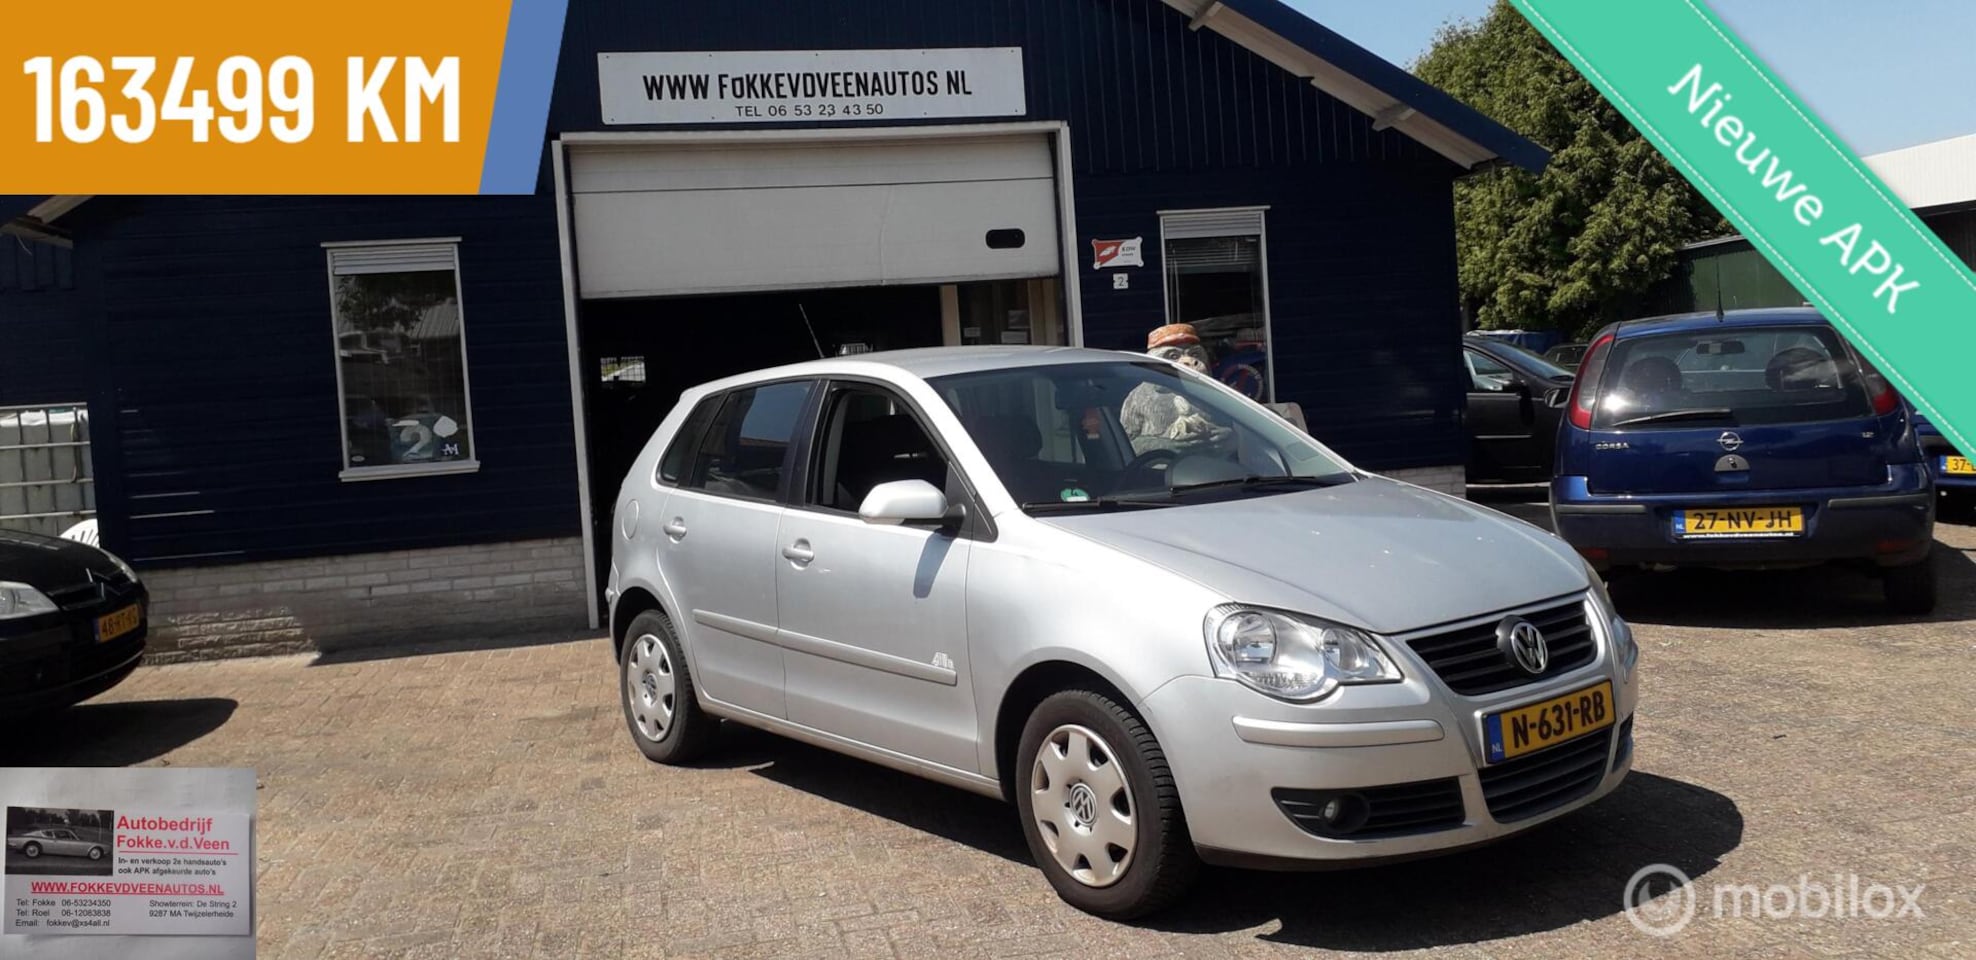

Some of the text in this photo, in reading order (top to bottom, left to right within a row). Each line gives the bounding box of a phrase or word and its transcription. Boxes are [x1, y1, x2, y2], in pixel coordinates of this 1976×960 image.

[643, 74, 709, 100] WWW
[946, 70, 972, 95] NL
[735, 103, 884, 117] TEL 06 53 23 43 50
[1693, 510, 1793, 530] 27-NV-JH
[1511, 690, 1605, 748] N-631-RB
